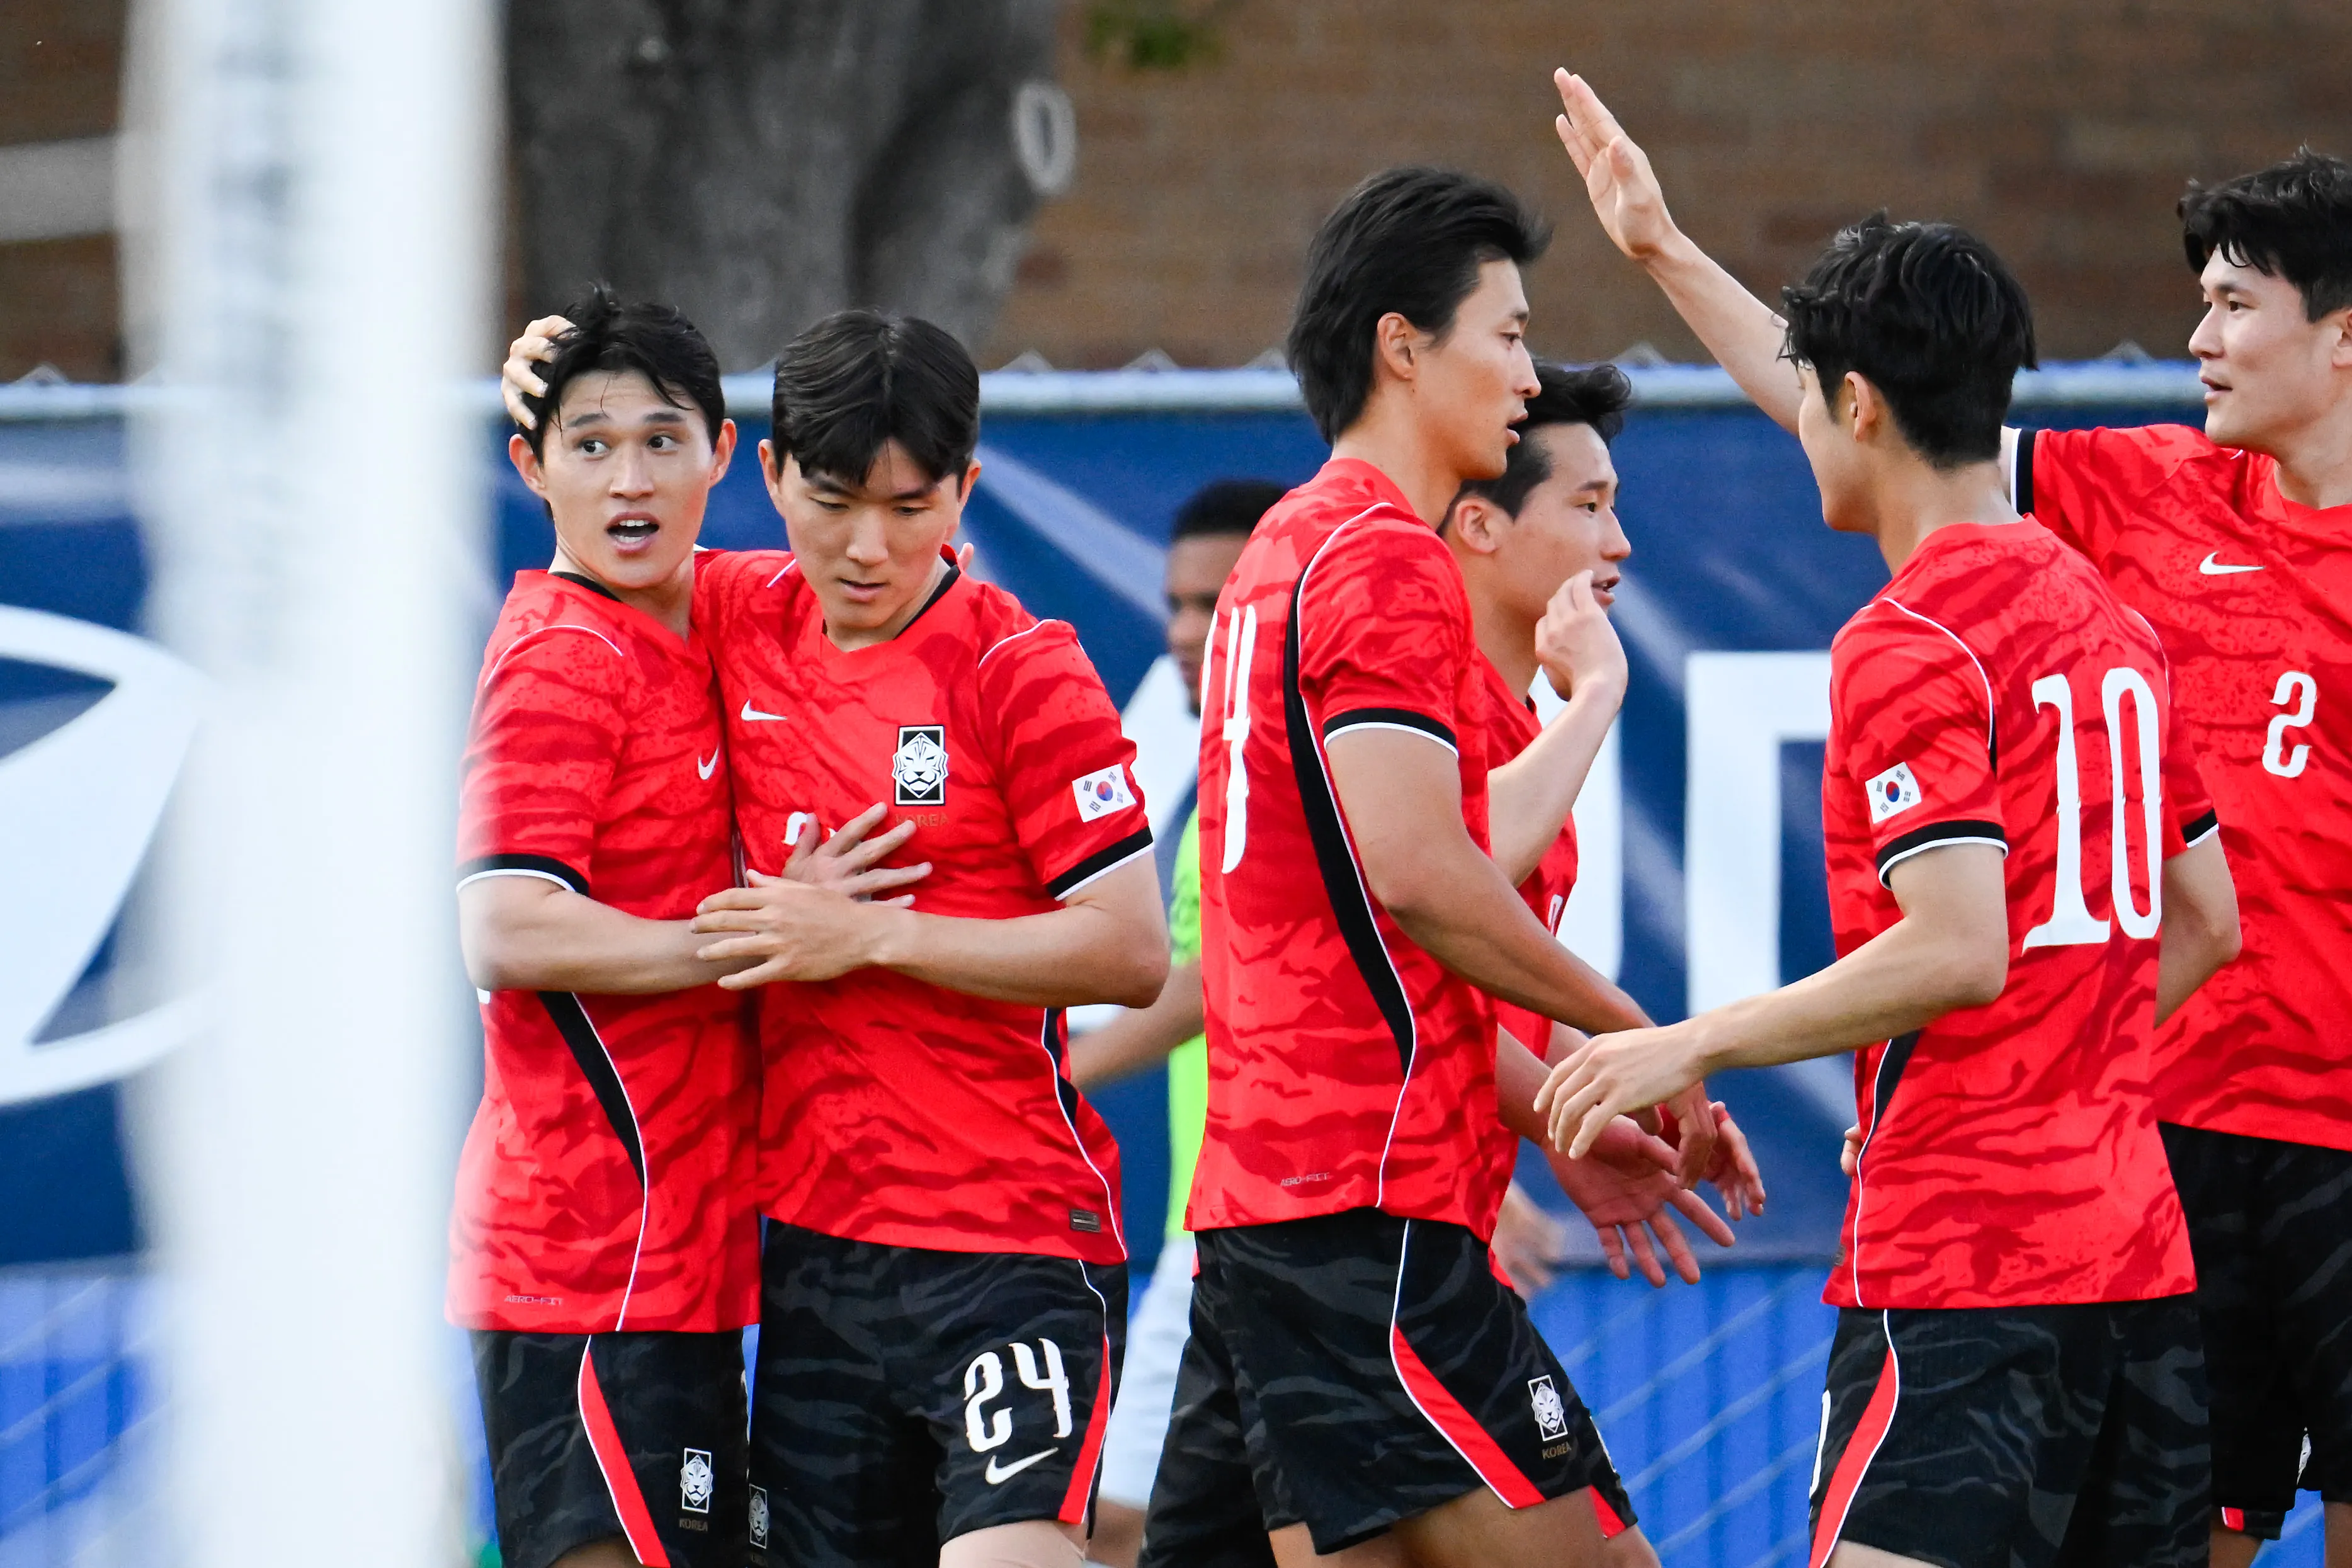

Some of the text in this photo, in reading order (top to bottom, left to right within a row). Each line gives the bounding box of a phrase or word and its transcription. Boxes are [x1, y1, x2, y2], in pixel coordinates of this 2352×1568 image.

[2262, 671, 2317, 778] 2
[2021, 667, 2162, 957] 10
[1280, 1172, 1329, 1187] AERO-FIT
[504, 1295, 563, 1305] AERO-FIT
[964, 1338, 1072, 1452] 24
[1542, 1441, 1571, 1459] KOREA
[679, 1518, 708, 1532] KOREA
